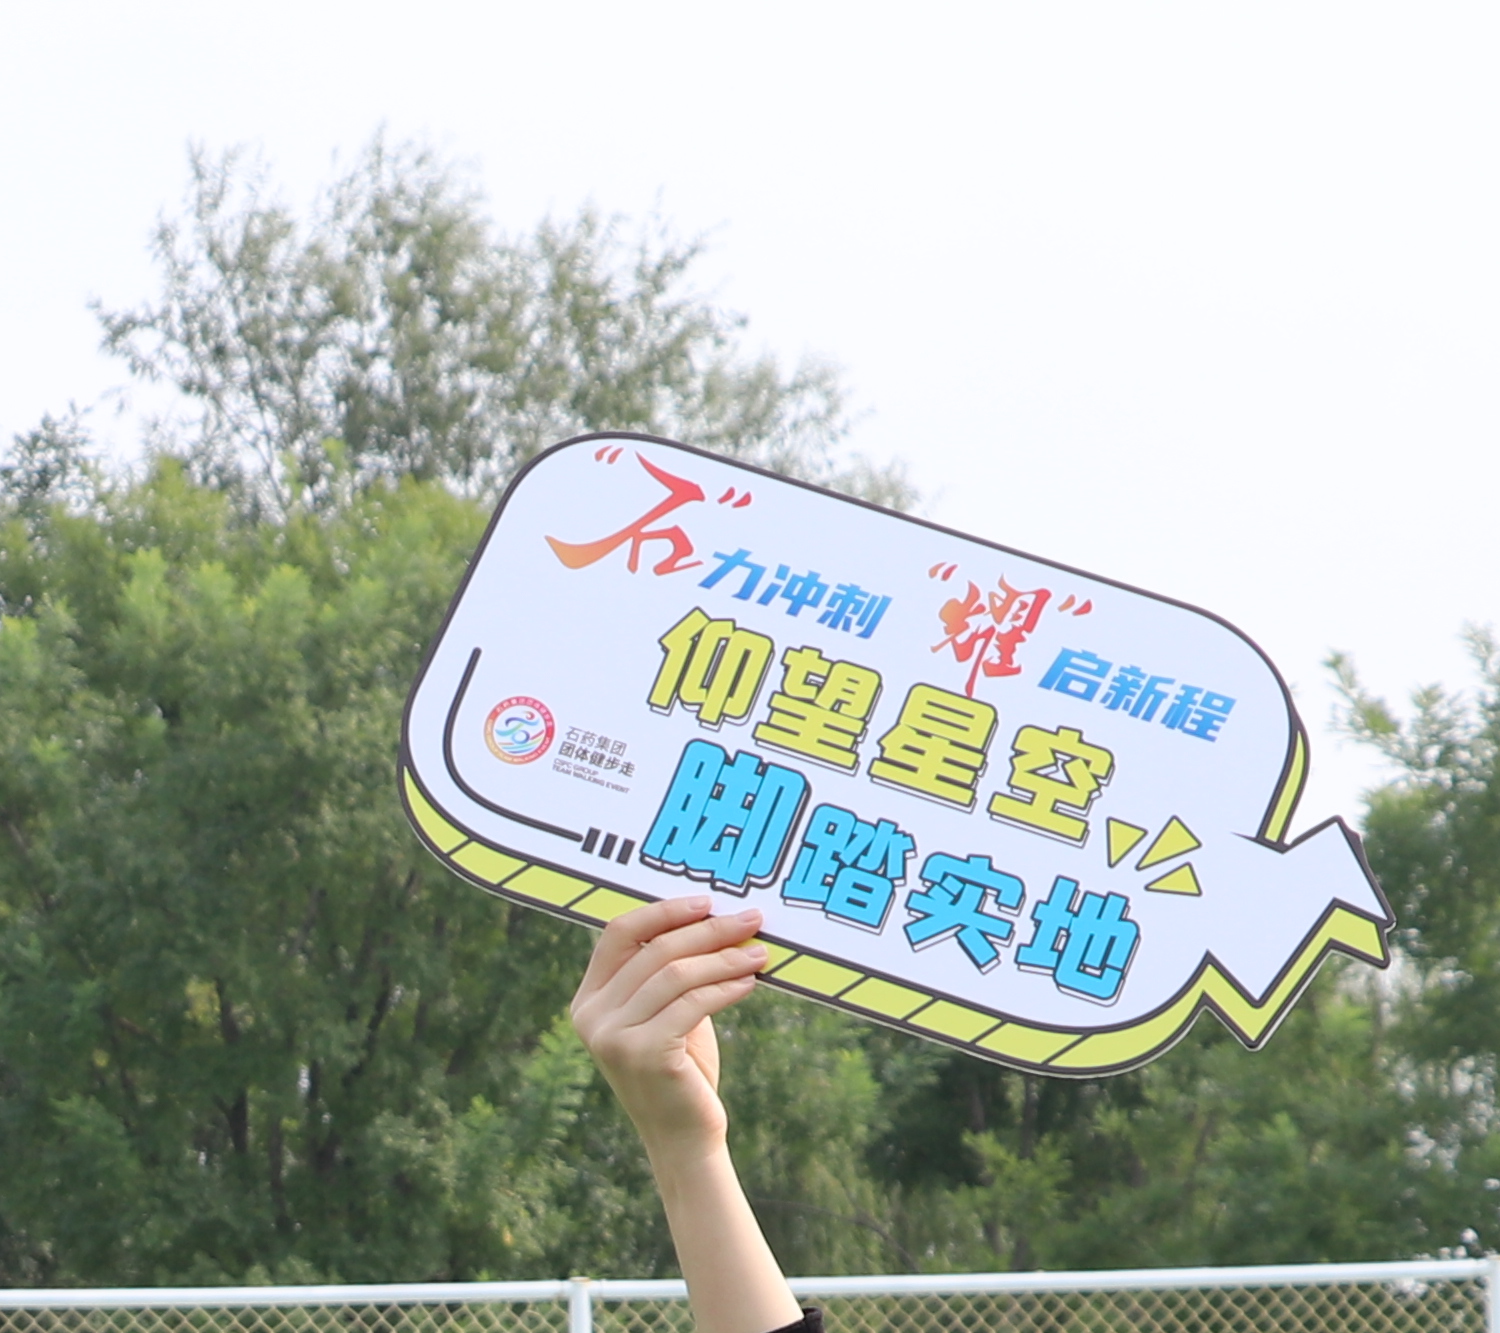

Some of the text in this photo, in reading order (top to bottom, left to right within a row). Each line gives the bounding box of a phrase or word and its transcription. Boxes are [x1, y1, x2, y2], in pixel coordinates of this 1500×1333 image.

[558, 741, 635, 778] 团体健步走
[566, 725, 627, 757] 石药集团
[648, 607, 1116, 847] 仰望星空
[640, 737, 1142, 1007] 脚踏实地
